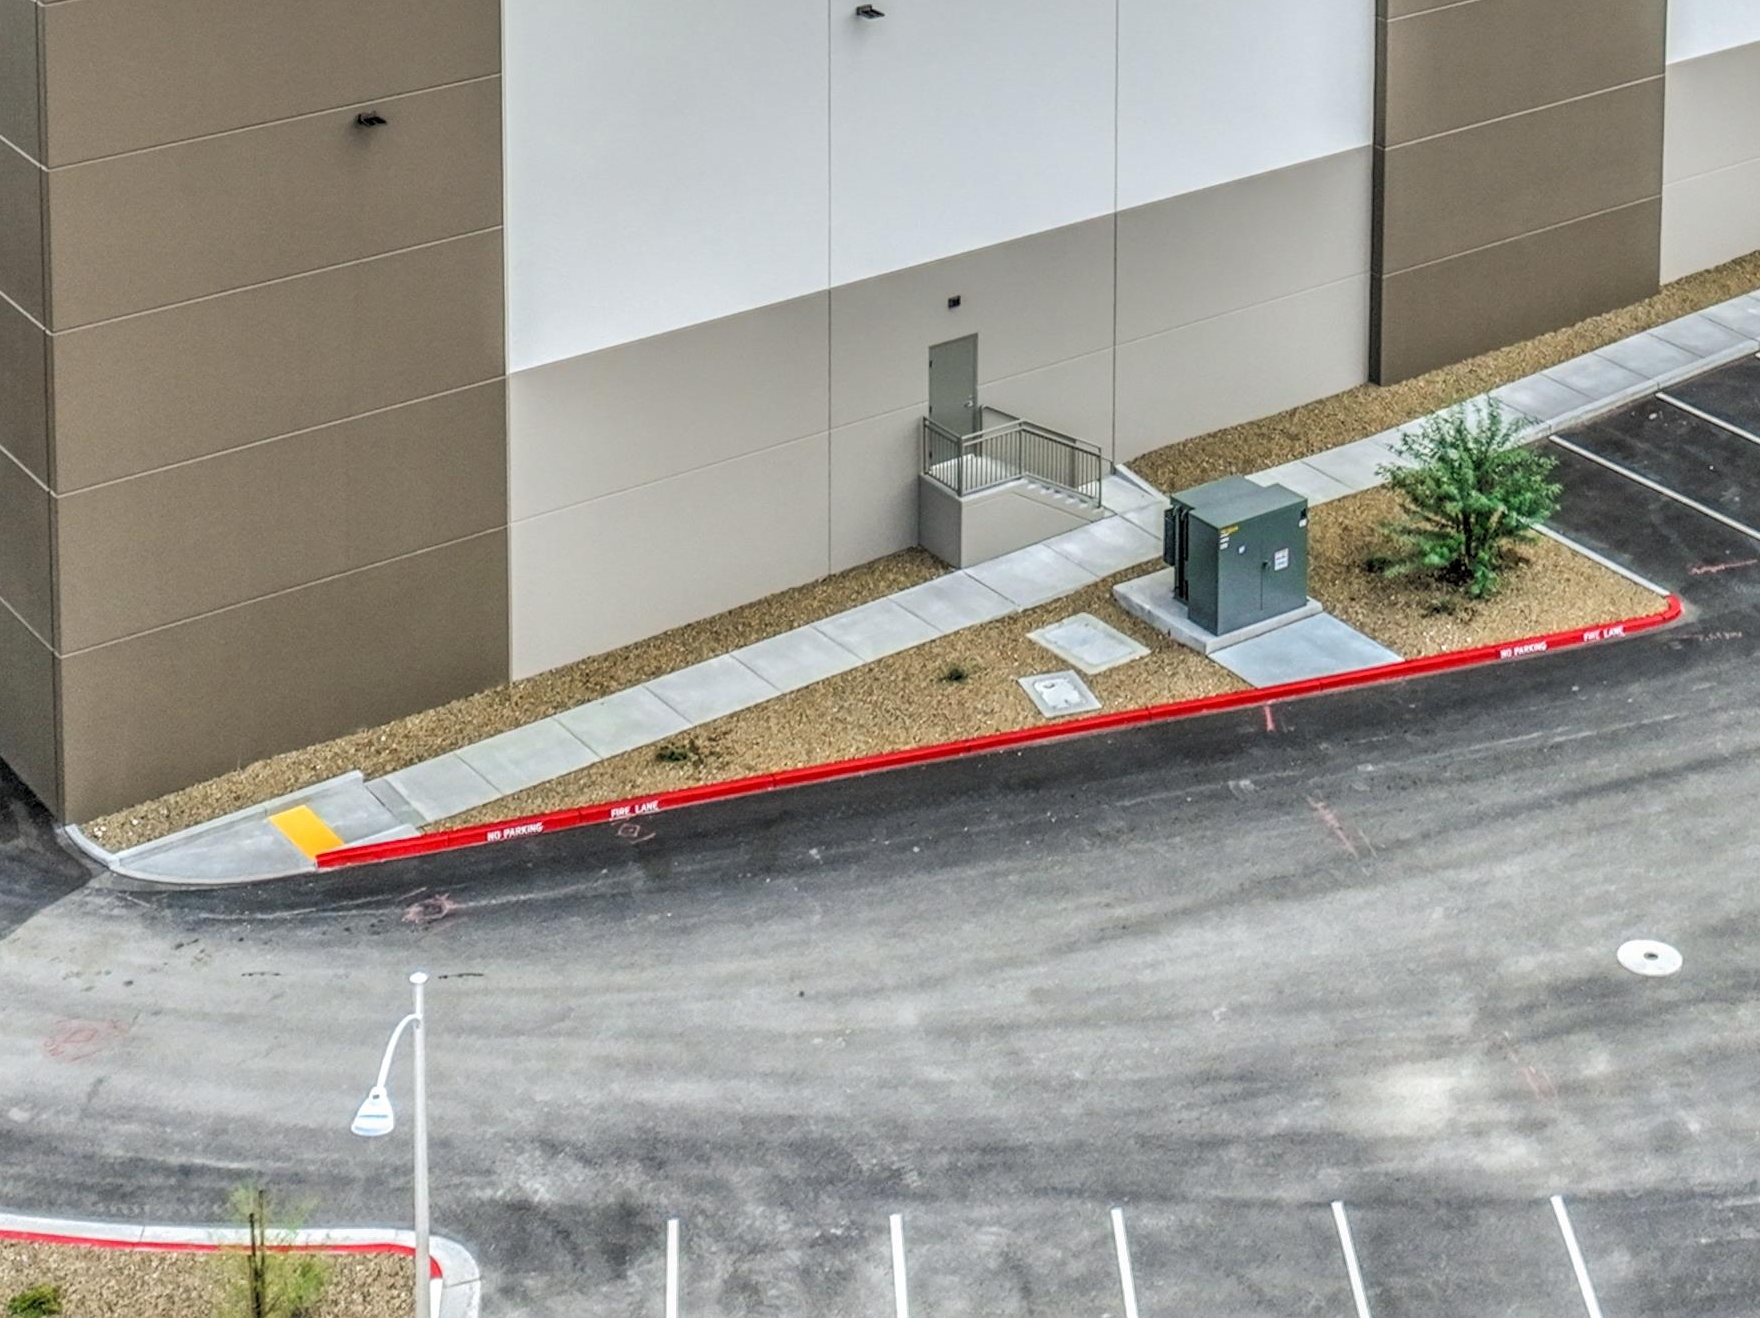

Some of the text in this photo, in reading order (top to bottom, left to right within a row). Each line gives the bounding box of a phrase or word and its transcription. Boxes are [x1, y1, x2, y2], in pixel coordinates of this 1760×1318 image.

[487, 800, 660, 842] NO PARKING FIRE LANE
